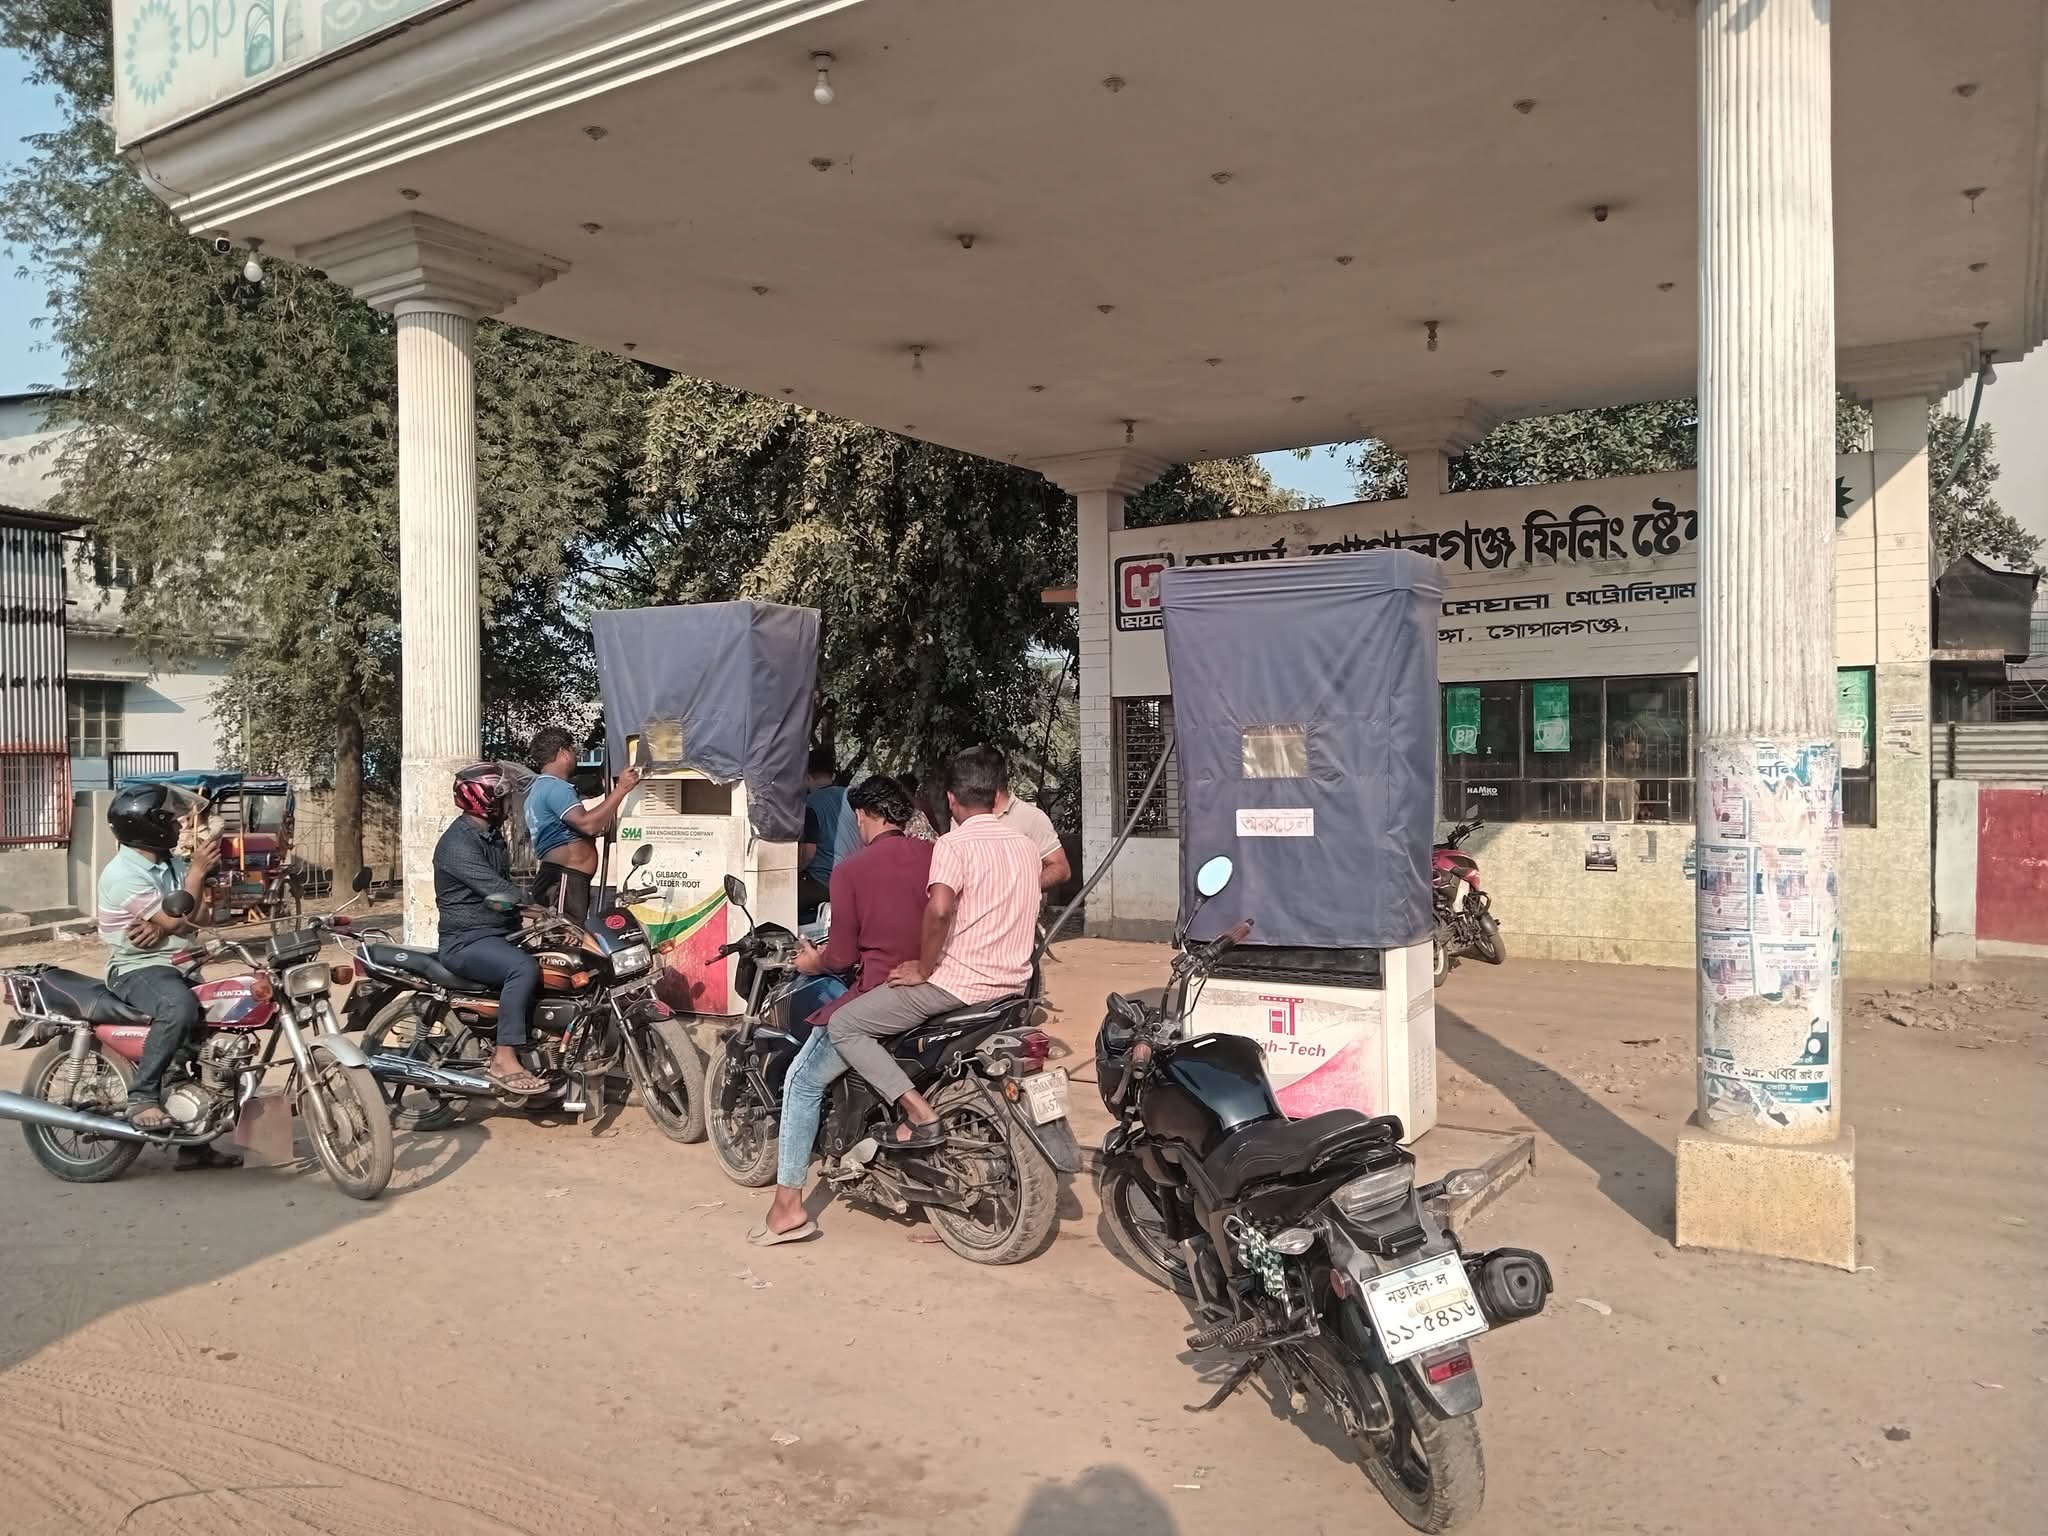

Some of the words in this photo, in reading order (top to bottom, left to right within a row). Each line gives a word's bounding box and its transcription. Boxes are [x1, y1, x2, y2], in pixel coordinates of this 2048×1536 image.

[1522, 504, 1628, 564] ফিলিং
[1467, 786, 1498, 794] HAMKO
[621, 828, 642, 839] SMA
[656, 871, 688, 879] GILBARCO
[656, 880, 701, 889] VEEDER-ROOT
[213, 989, 252, 998] HONDA
